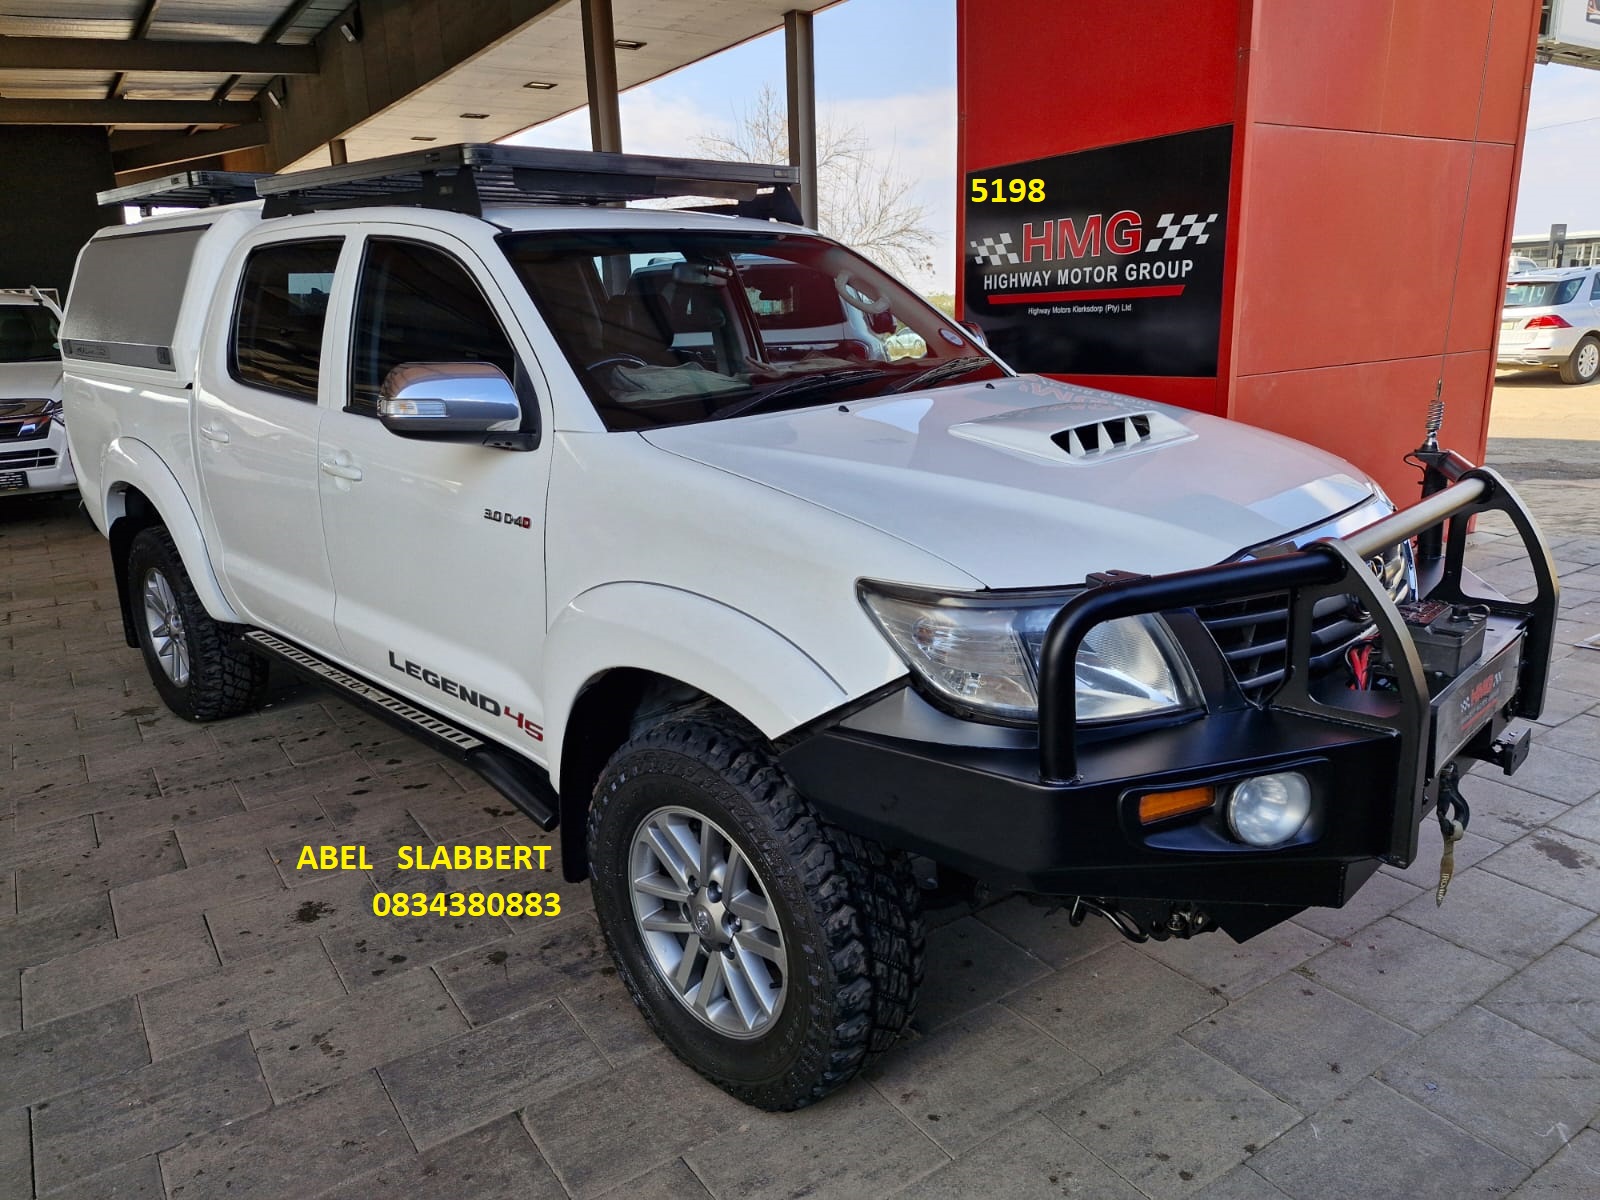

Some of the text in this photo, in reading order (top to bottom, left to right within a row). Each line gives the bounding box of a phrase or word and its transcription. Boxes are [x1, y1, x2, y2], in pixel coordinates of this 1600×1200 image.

[1022, 210, 1142, 263] HMG
[984, 259, 1194, 290] HIGHWAY MOTOR GROUP
[1028, 307, 1051, 316] Highway
[1052, 306, 1071, 314] Motors
[1105, 303, 1120, 313] (Pty)
[1121, 303, 1132, 312] Ltd
